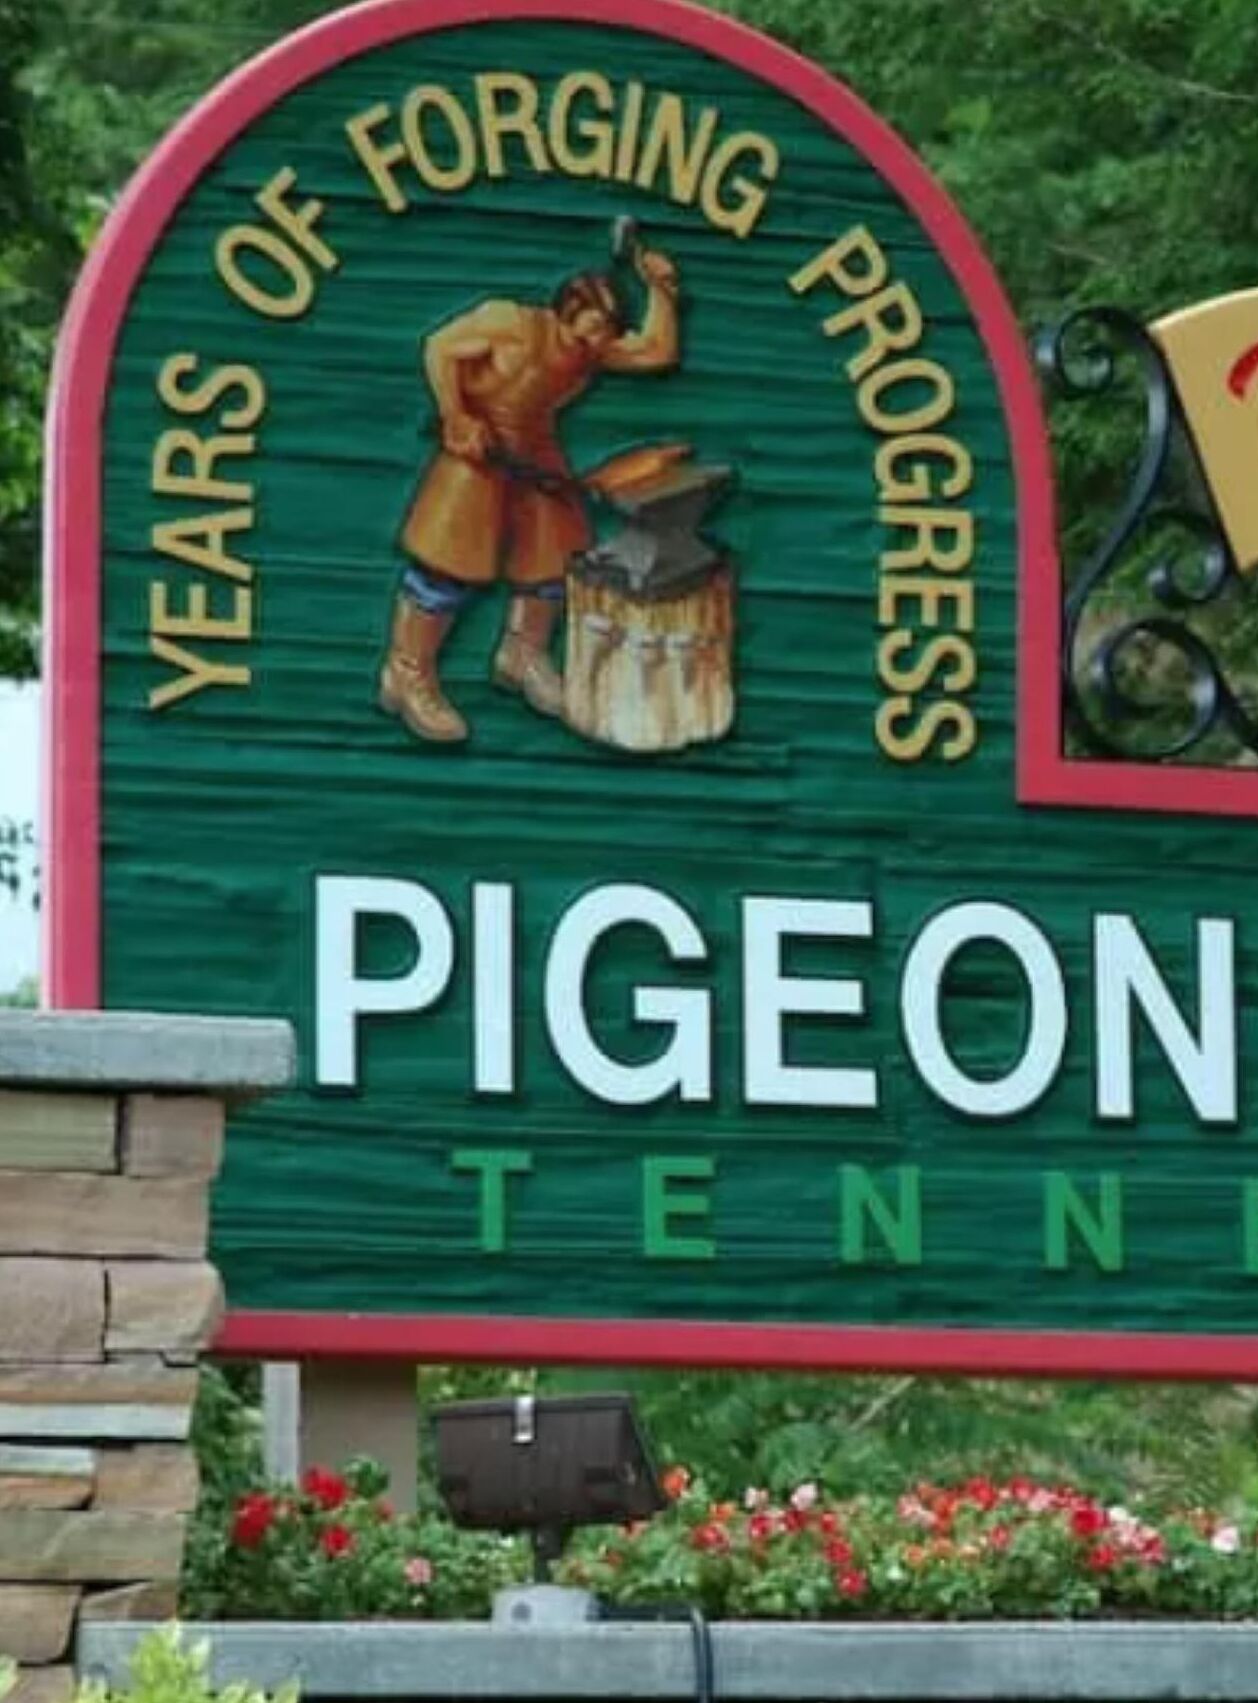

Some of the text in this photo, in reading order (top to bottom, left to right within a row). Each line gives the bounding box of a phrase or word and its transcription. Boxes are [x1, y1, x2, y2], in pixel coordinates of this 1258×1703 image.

[150, 72, 977, 762] YEARS OF FORGING PROGRESS
[314, 875, 1237, 1122] PIGEON
